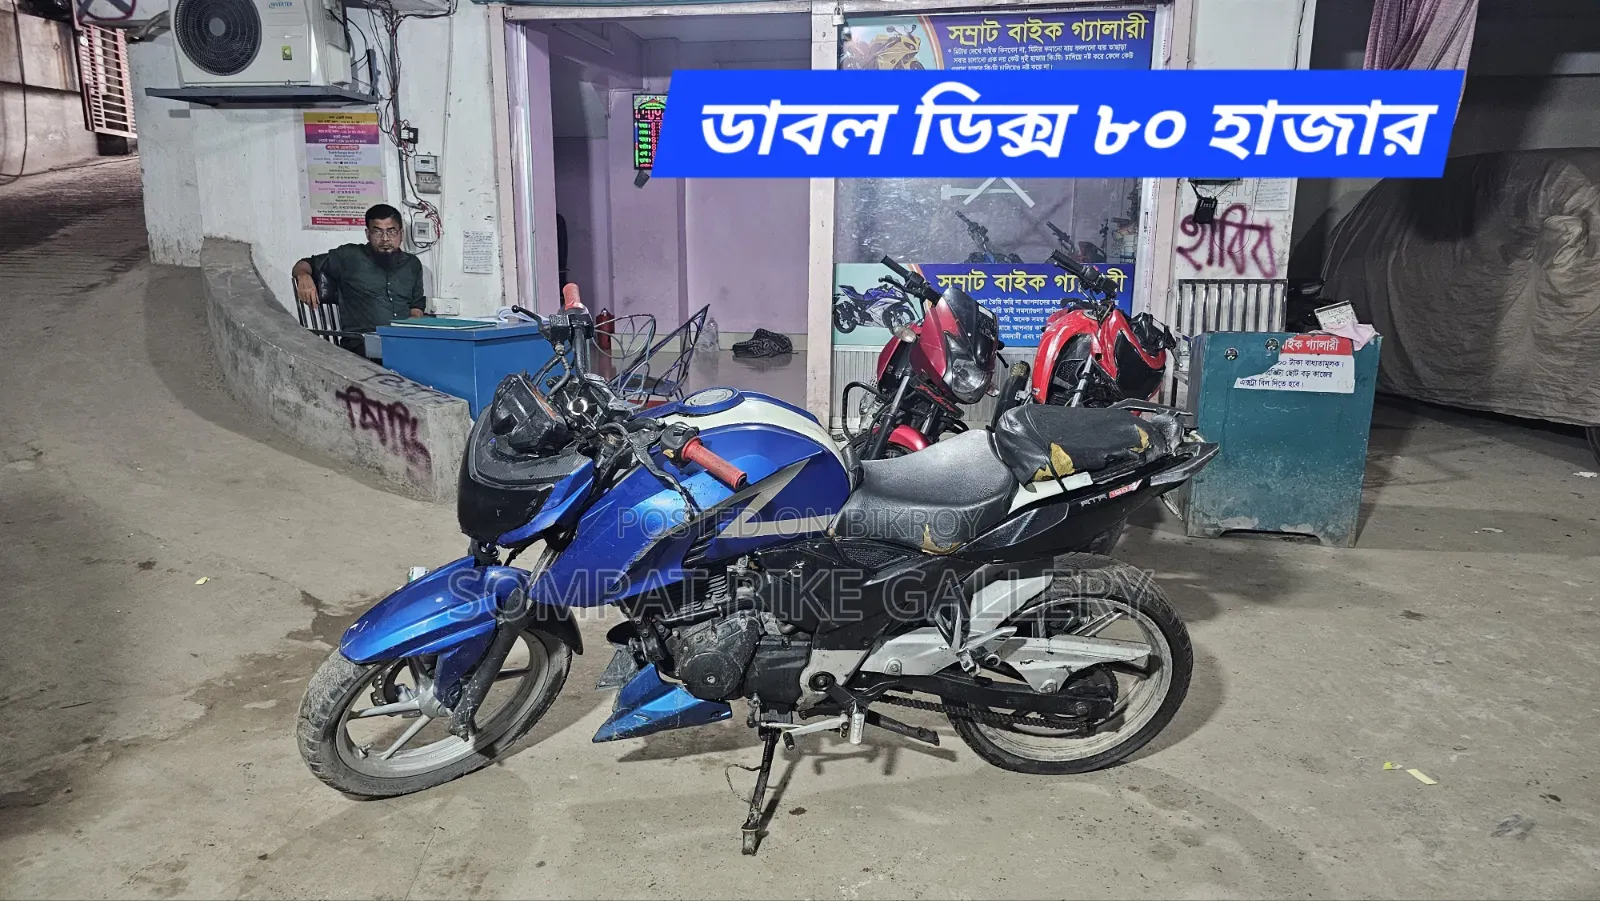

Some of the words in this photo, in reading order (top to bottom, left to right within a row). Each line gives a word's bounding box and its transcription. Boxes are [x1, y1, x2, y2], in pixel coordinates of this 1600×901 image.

[947, 18, 1002, 47] সম্রাট
[1006, 17, 1065, 44] বাইক
[1071, 12, 1150, 42] গ্যালারী
[992, 269, 1048, 294] বাইক
[1306, 337, 1340, 352] গ্যালারী
[1288, 358, 1304, 366] টাকা
